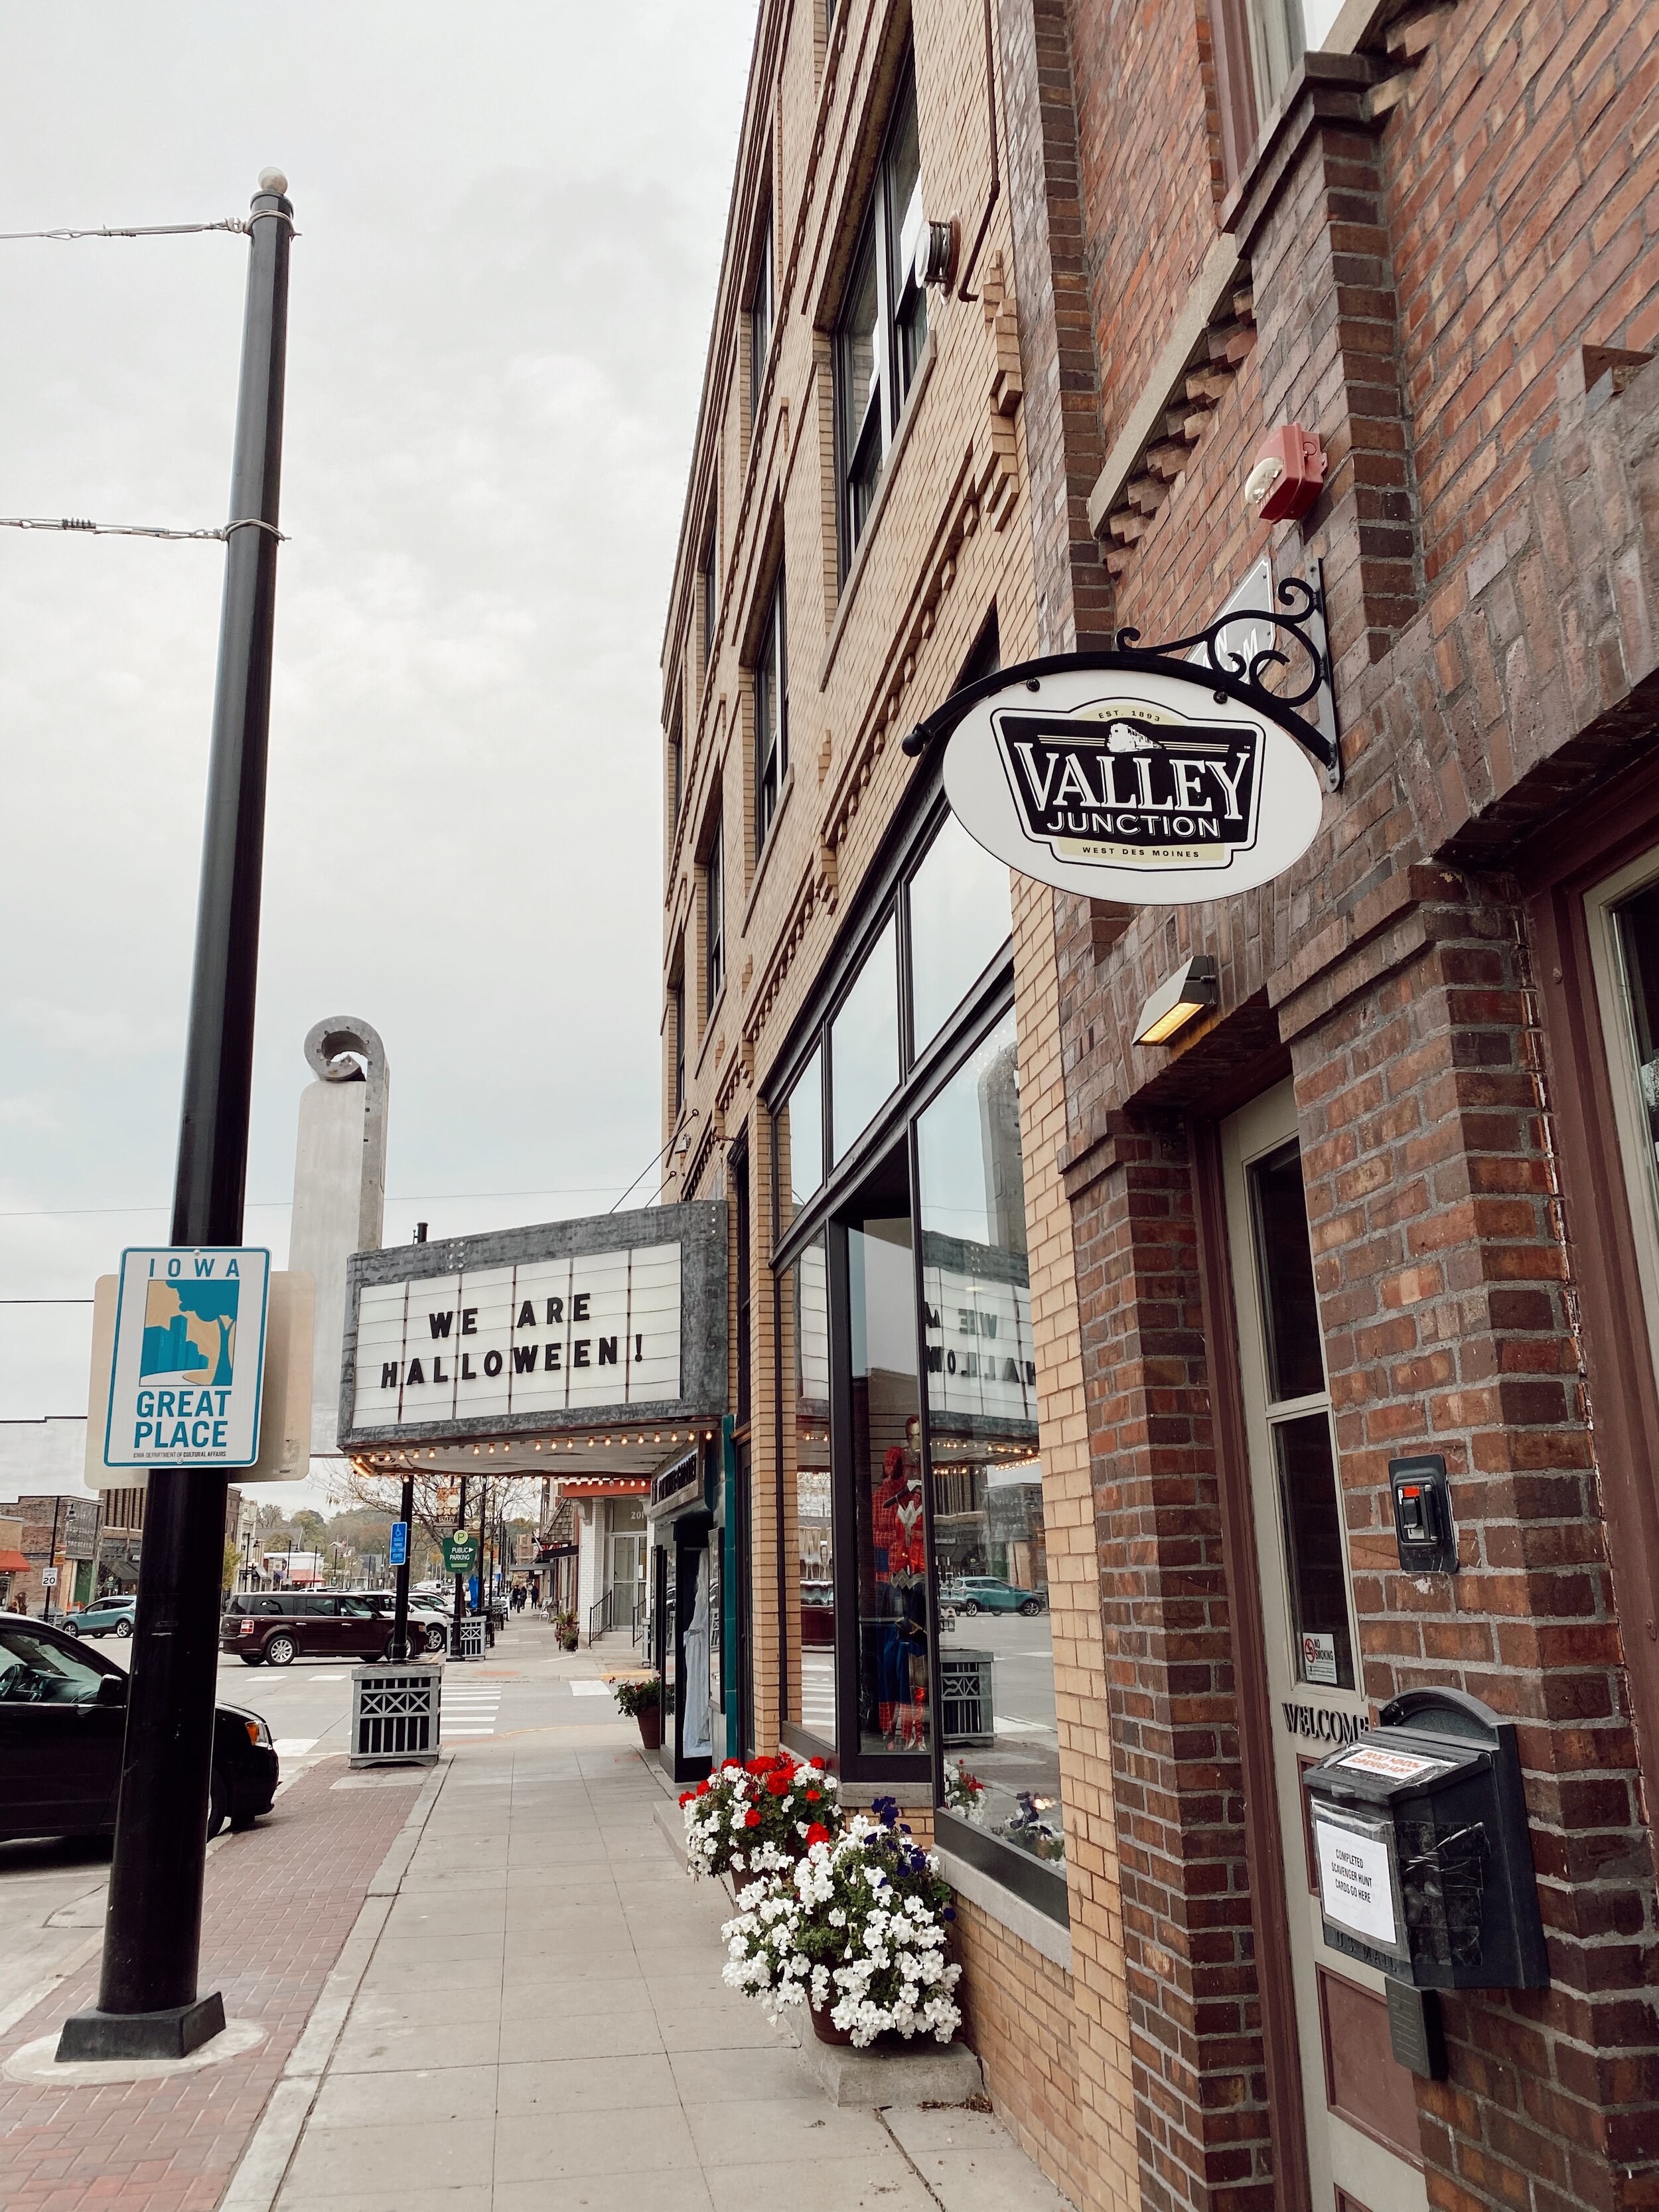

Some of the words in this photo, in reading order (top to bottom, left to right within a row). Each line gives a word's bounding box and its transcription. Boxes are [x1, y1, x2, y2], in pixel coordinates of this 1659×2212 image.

[1098, 710, 1123, 719] EST.
[1131, 710, 1160, 721] 1893
[1013, 742, 1250, 820] VALLEY
[1046, 812, 1221, 838] JUNCTION
[1082, 846, 1115, 855] WEST
[149, 1258, 240, 1278] IOWA
[429, 1307, 478, 1339] WE
[516, 1292, 591, 1328] ARE
[380, 1333, 642, 1389] HALLOWEEN!
[136, 1390, 232, 1418] GREAT
[133, 1420, 228, 1449] PLACE
[457, 1532, 465, 1542] P
[1281, 1702, 1370, 1745] WELCOME
[1335, 1848, 1364, 1869] COMPLETED
[1331, 1862, 1358, 1882] SCAVENGER
[1358, 1873, 1372, 1887] HUNT
[1334, 1878, 1350, 1894] CARDS
[1350, 1885, 1358, 1897] GO
[1358, 1889, 1372, 1903] HERE
[1362, 1944, 1397, 1972] MAIL
